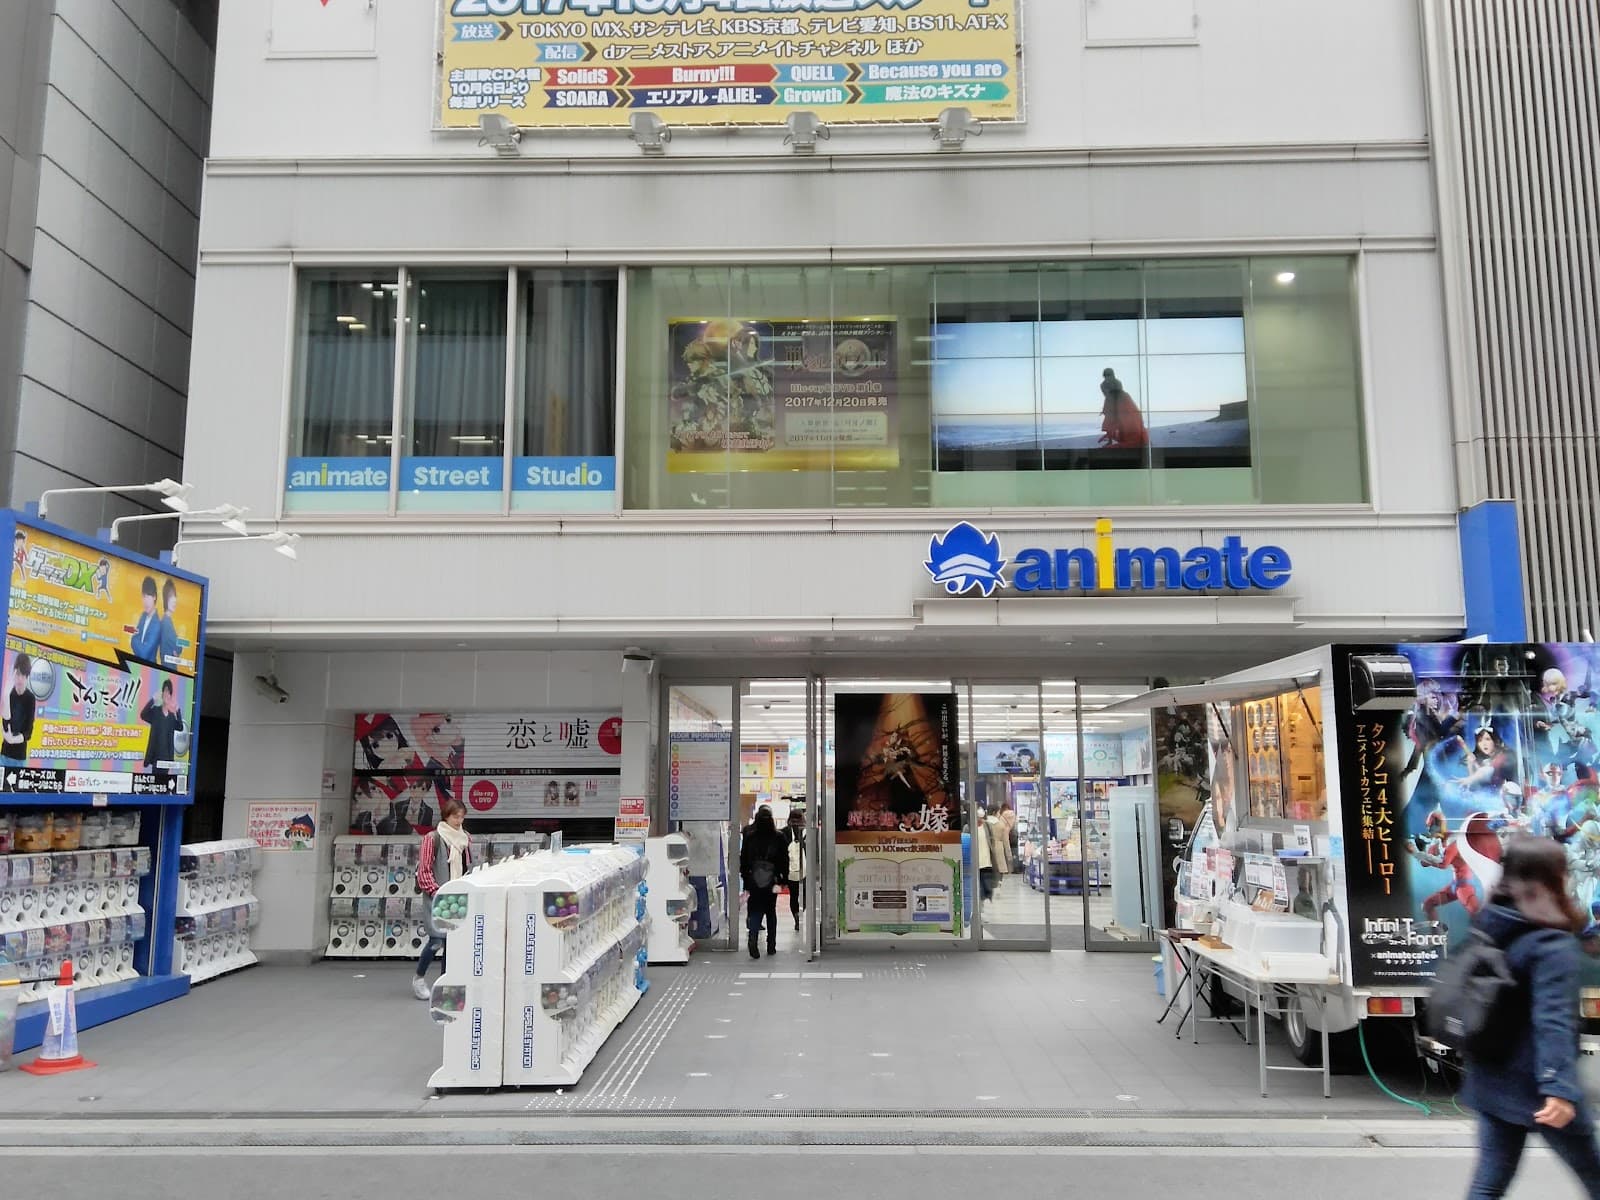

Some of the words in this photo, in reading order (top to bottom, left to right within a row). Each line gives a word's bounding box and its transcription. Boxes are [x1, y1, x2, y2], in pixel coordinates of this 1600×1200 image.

[461, 25, 494, 39] 放送
[519, 23, 587, 38] TOKYO
[545, 45, 578, 60] 配信
[603, 39, 880, 60] dアニメストア、アニメイトチャンネル
[886, 38, 923, 55] ほか
[556, 69, 608, 85] SolidS
[672, 66, 735, 83] Burny!!!
[791, 65, 835, 81] QUELL
[868, 63, 938, 80] Because
[941, 62, 971, 78] you
[974, 63, 1002, 77] are
[450, 81, 530, 95] 10月6日より
[784, 88, 842, 103] Growth
[885, 84, 986, 101] 魔法のキズナ
[448, 95, 526, 108] 毎週リリース
[556, 90, 609, 106] SOARA
[646, 89, 709, 105] エリアル
[711, 88, 762, 104] -ALIEL-
[784, 396, 888, 408] 2017年12月20日発売
[291, 463, 388, 486] animate
[413, 466, 490, 486] Street
[526, 462, 602, 486] Studio
[1014, 519, 1293, 591] animate
[506, 718, 590, 749] 恋と嘘
[1371, 722, 1394, 896] タツノコ4大ヒーロー
